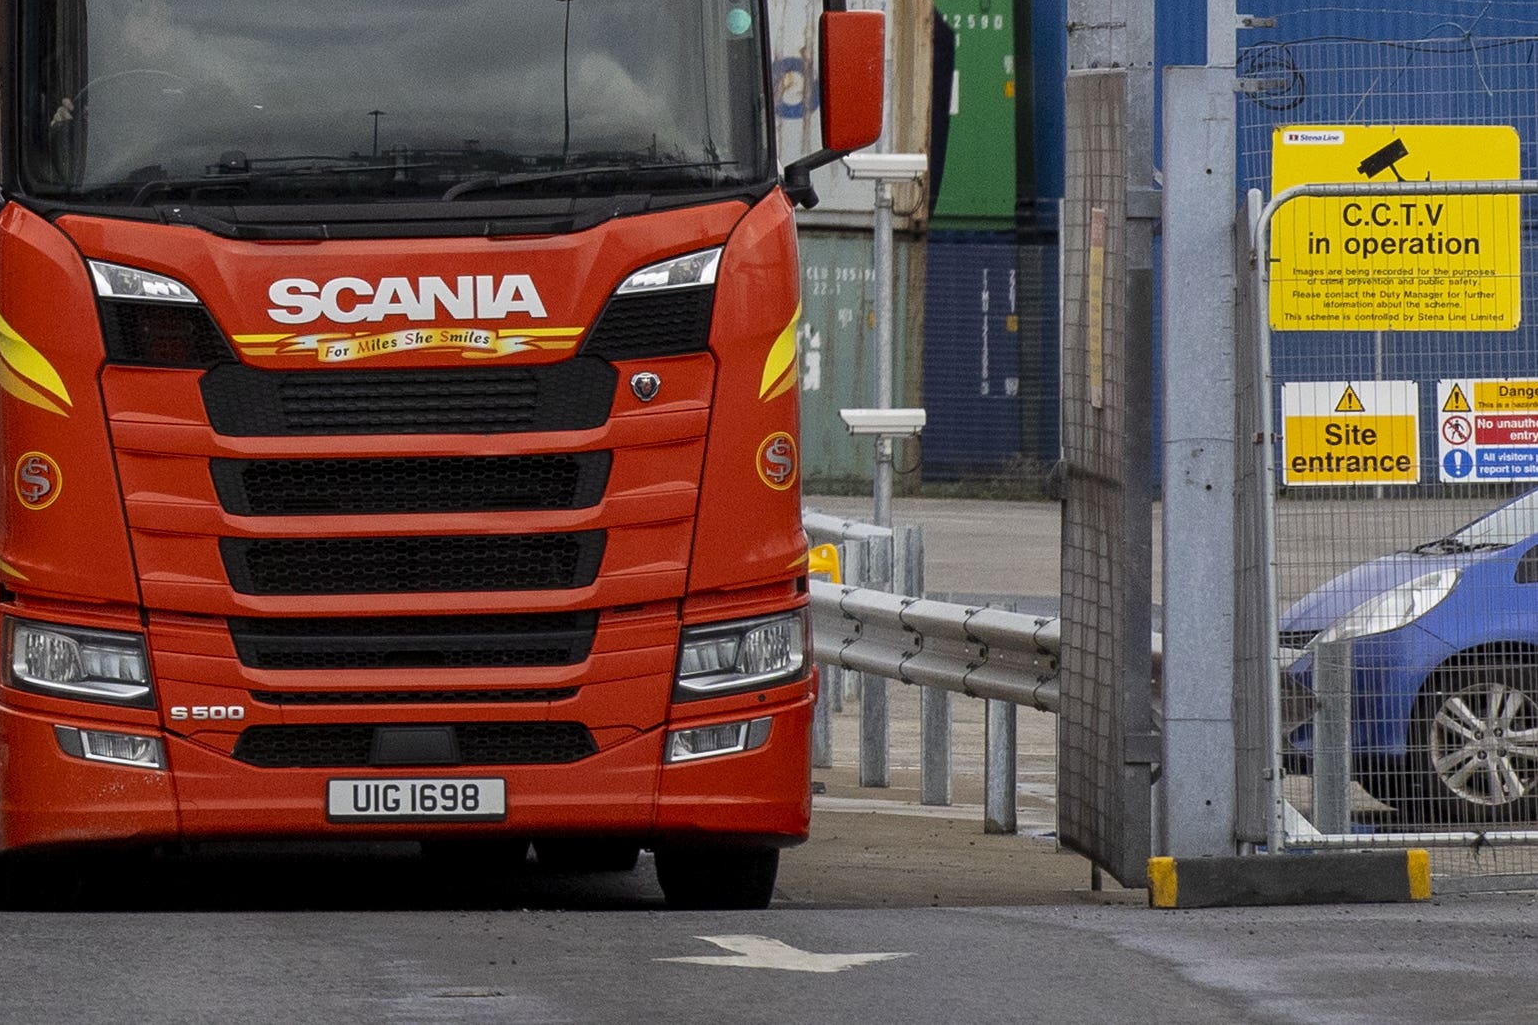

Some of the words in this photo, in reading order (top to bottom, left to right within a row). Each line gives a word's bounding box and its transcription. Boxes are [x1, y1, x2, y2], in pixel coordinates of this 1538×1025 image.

[1342, 202, 1444, 227] C.C.T.V
[1308, 231, 1330, 255] in
[1344, 231, 1480, 260] operation
[1292, 267, 1325, 278] Images
[1345, 267, 1370, 278] being
[1372, 267, 1414, 276] recorded
[1416, 267, 1431, 276] for
[1433, 267, 1449, 276] the
[1452, 269, 1496, 278] purposes
[267, 274, 548, 324] SCANIA
[1292, 290, 1322, 299] Please
[1324, 290, 1359, 299] contact
[1362, 290, 1376, 299] the
[1379, 290, 1401, 301] Duty
[1403, 290, 1444, 301] Manager
[1447, 290, 1460, 299] for
[1464, 290, 1495, 299] further
[1284, 312, 1303, 321] This
[1305, 312, 1340, 321] scheme
[1342, 312, 1351, 321] is
[1354, 312, 1400, 321] controlled
[1402, 312, 1414, 323] by
[1417, 312, 1445, 321] Stena
[1447, 312, 1467, 321] Line
[1470, 312, 1504, 321] Limited
[324, 345, 350, 359] For
[356, 337, 398, 354] Miles
[404, 332, 434, 346] She
[439, 330, 491, 346] Smiles
[1477, 419, 1494, 429] No
[1325, 422, 1377, 446] Site
[1509, 430, 1538, 443] entry
[1291, 451, 1411, 474] entrance
[1482, 452, 1496, 462] All
[1497, 452, 1534, 462] visitors
[1479, 464, 1510, 476] report
[1511, 464, 1523, 474] to
[191, 705, 245, 719] 500
[353, 783, 401, 812] UIG
[409, 782, 481, 812] 1698
